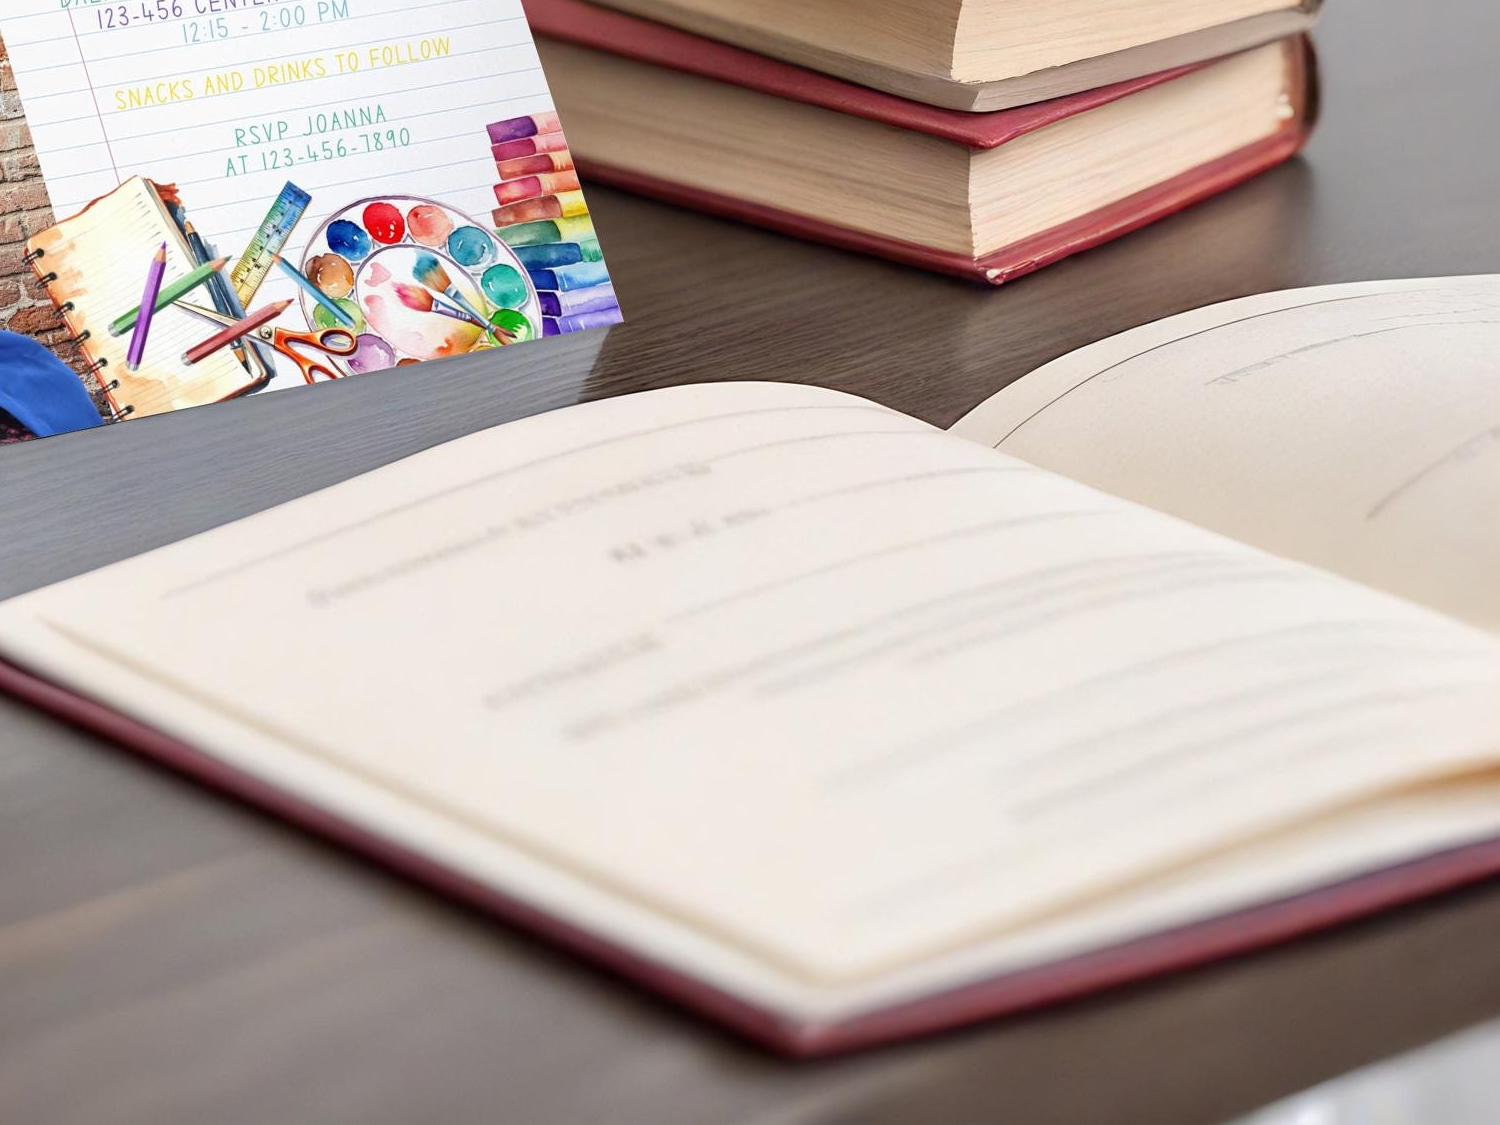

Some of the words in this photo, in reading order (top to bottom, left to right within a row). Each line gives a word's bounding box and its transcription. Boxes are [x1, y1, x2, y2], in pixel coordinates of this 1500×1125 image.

[97, 2, 183, 30] 123-456
[183, 18, 228, 43] 12:15
[260, 5, 305, 31] 2:00
[115, 80, 193, 111] SNACKS
[205, 71, 243, 95] AND
[254, 57, 325, 89] DRINKS
[335, 52, 359, 73] TO
[370, 37, 451, 68] FOLLOW
[235, 121, 288, 147] RSVP
[303, 104, 387, 137] JOANNA
[226, 155, 248, 177] AT
[262, 127, 410, 170] 123-456-7890
